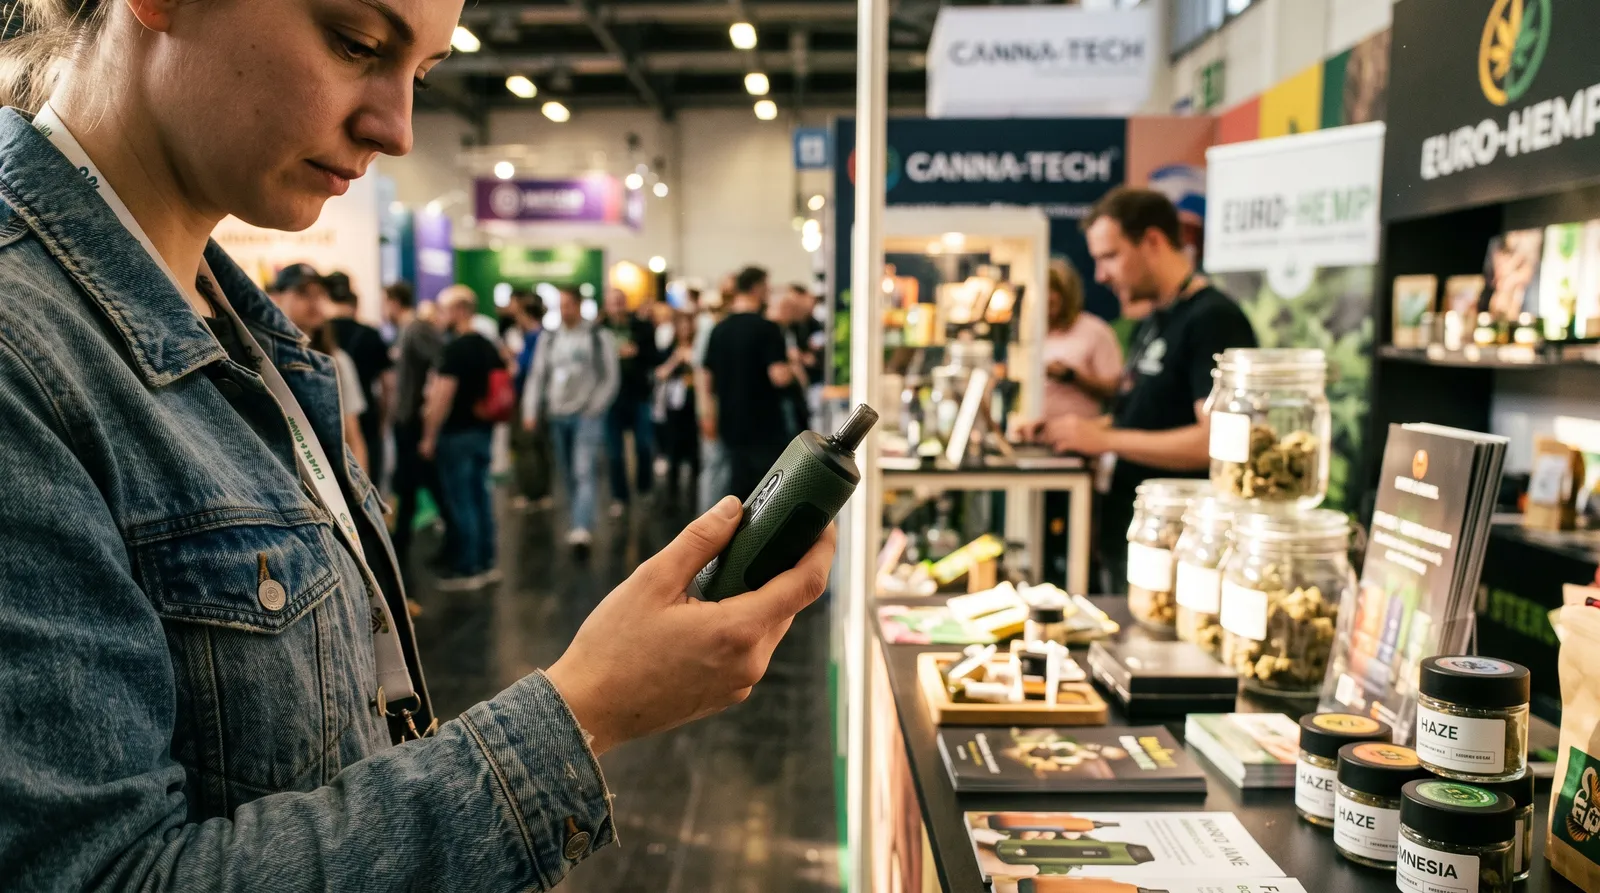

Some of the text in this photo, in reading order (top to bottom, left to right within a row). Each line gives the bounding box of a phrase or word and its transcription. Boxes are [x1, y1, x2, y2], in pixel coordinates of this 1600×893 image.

[1421, 716, 1459, 741] HAZE
[1300, 770, 1334, 792] HAZE
[1338, 805, 1376, 831] HAZE
[1398, 845, 1459, 880] MNESIA
